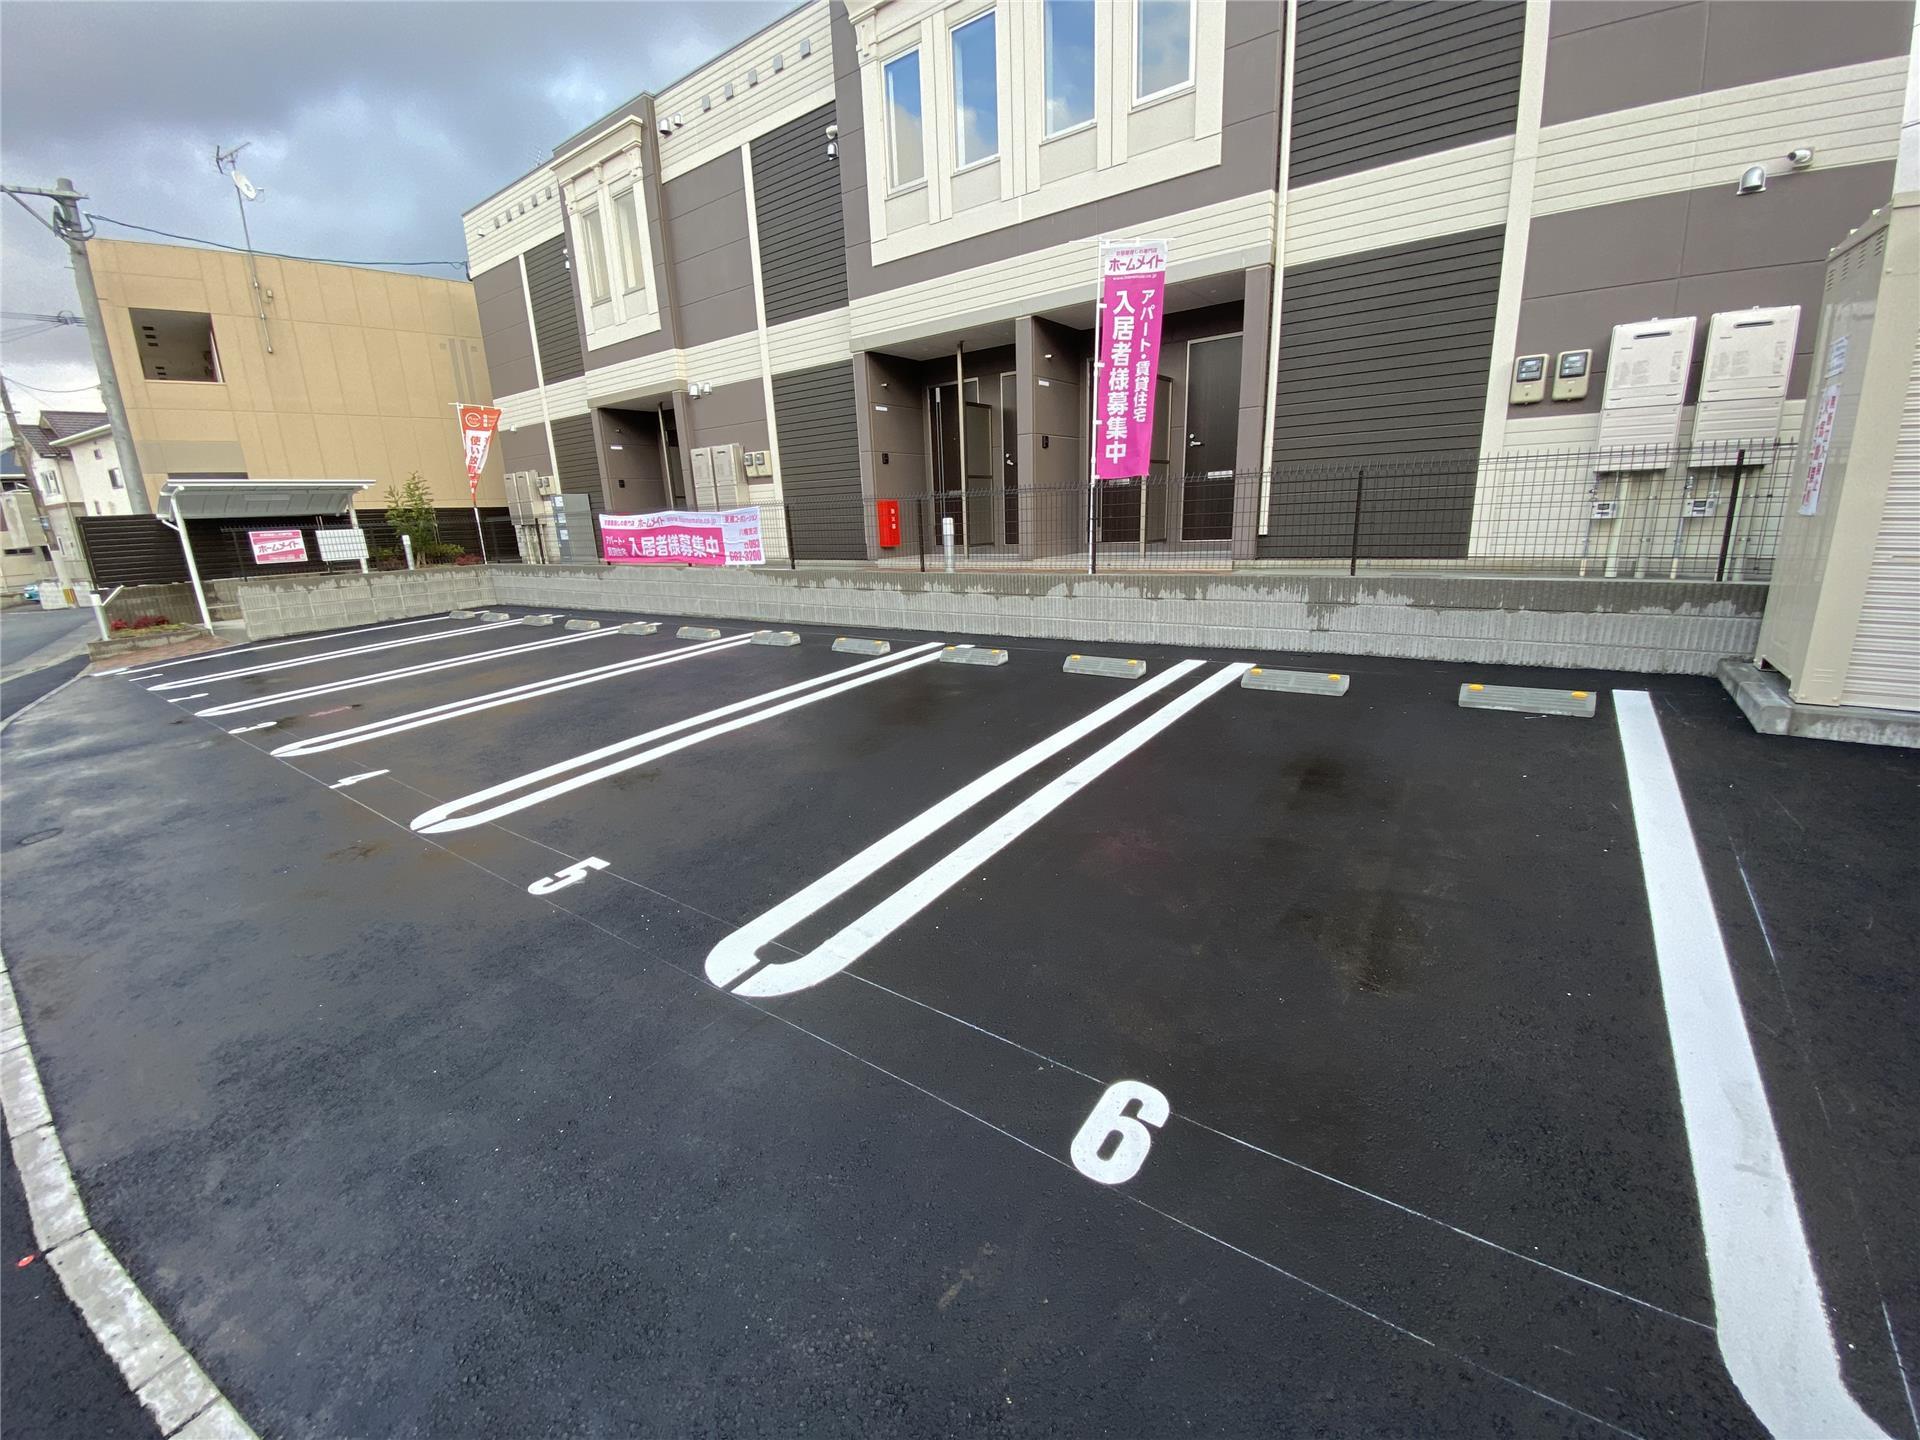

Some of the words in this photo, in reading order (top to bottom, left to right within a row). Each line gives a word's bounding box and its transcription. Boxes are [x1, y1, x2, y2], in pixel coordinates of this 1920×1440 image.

[1109, 254, 1164, 272] ホームメイト
[1132, 289, 1155, 423] アパート・賃貸住宅
[1105, 289, 1136, 465] 入居者様募集中
[637, 514, 665, 528] ホームメイト
[257, 540, 299, 553] ホームメイト
[628, 533, 720, 558] 入居者様募集中
[228, 721, 278, 735] 3
[328, 768, 391, 790] 4
[527, 856, 611, 895] 5
[1070, 1080, 1170, 1185] 6
